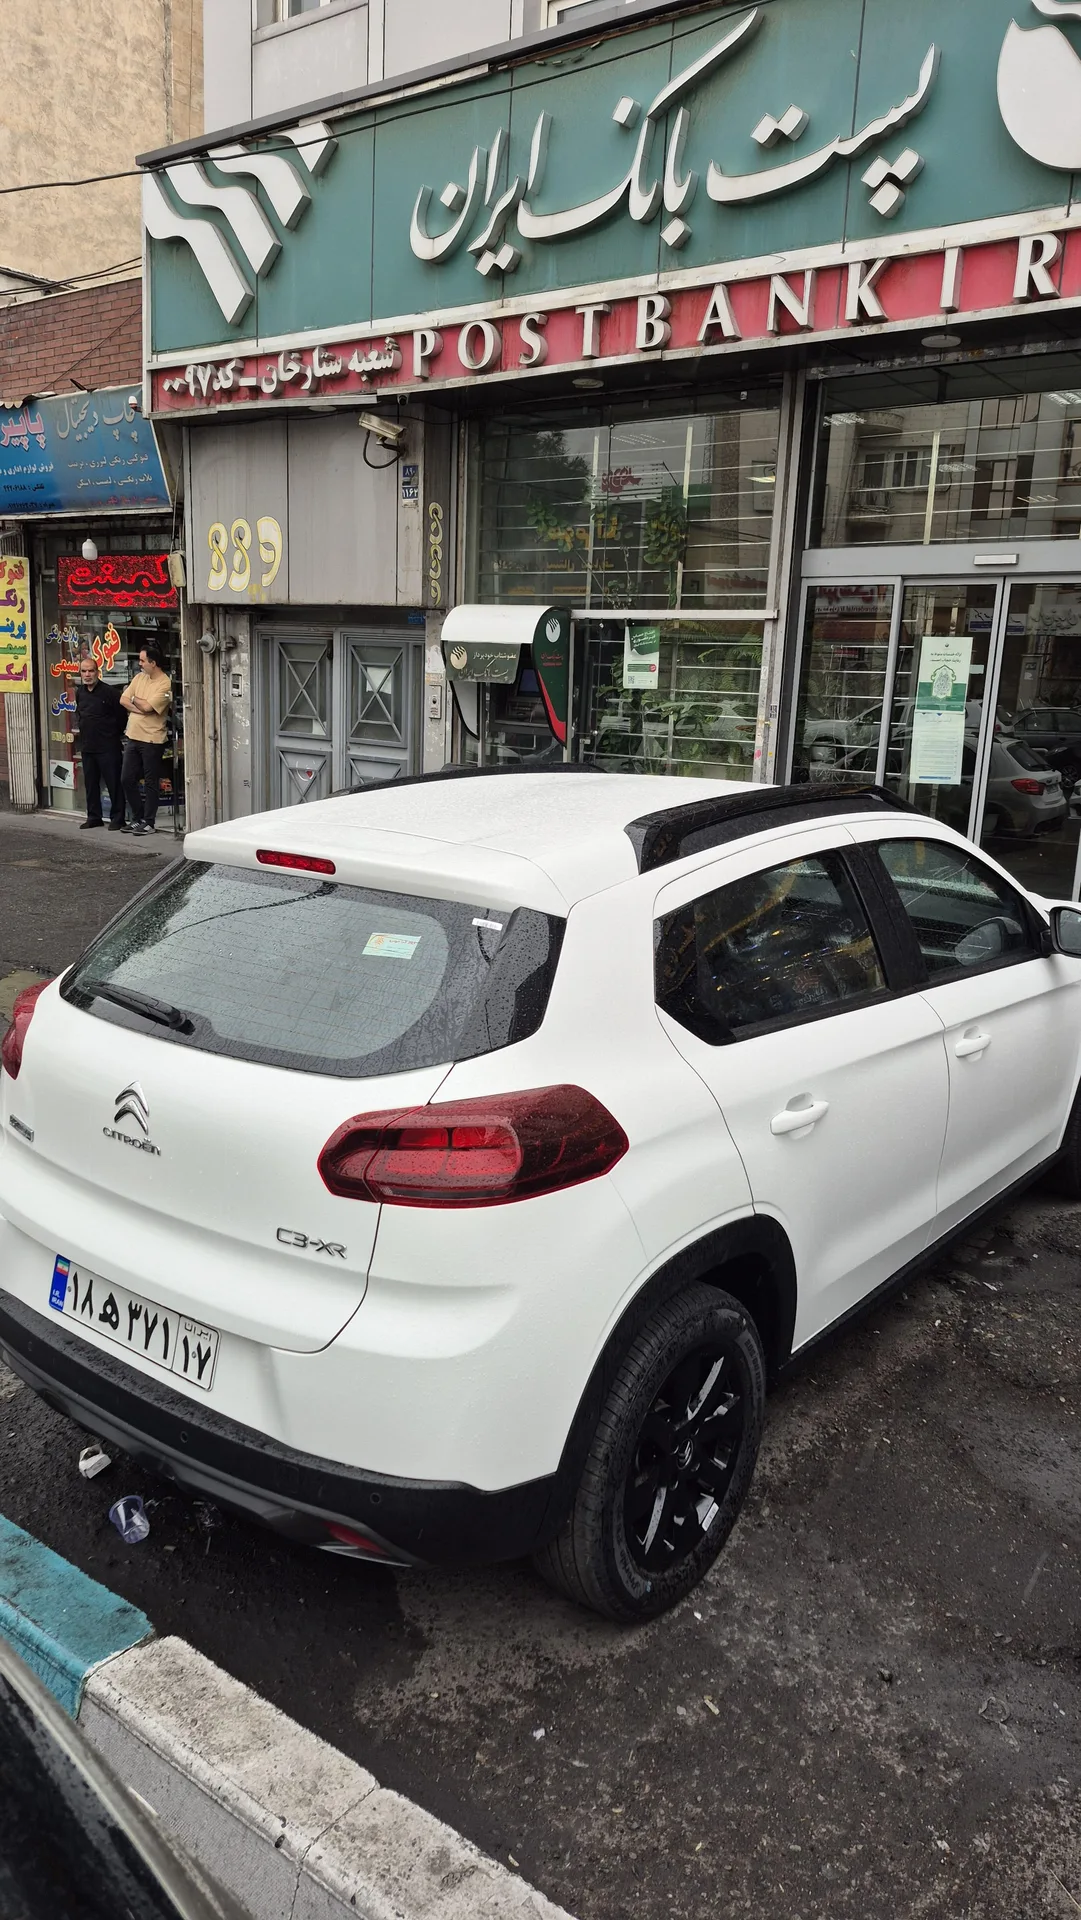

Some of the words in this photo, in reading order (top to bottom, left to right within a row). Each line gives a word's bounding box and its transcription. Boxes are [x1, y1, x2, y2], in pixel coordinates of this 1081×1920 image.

[516, 7, 764, 249] بانک
[706, 42, 941, 218] پست
[409, 110, 553, 276] ایران
[260, 345, 346, 394] ستارخان
[347, 336, 402, 382] شعبه
[57, 398, 99, 442] دیجیتال
[492, 668, 509, 681] پست
[103, 1127, 161, 1156] CITROËN
[276, 1227, 347, 1259] C3-XR
[51, 1296, 63, 1307] IRAN
[184, 1321, 212, 1342] ایران
[182, 1334, 211, 1381] ۱۷
